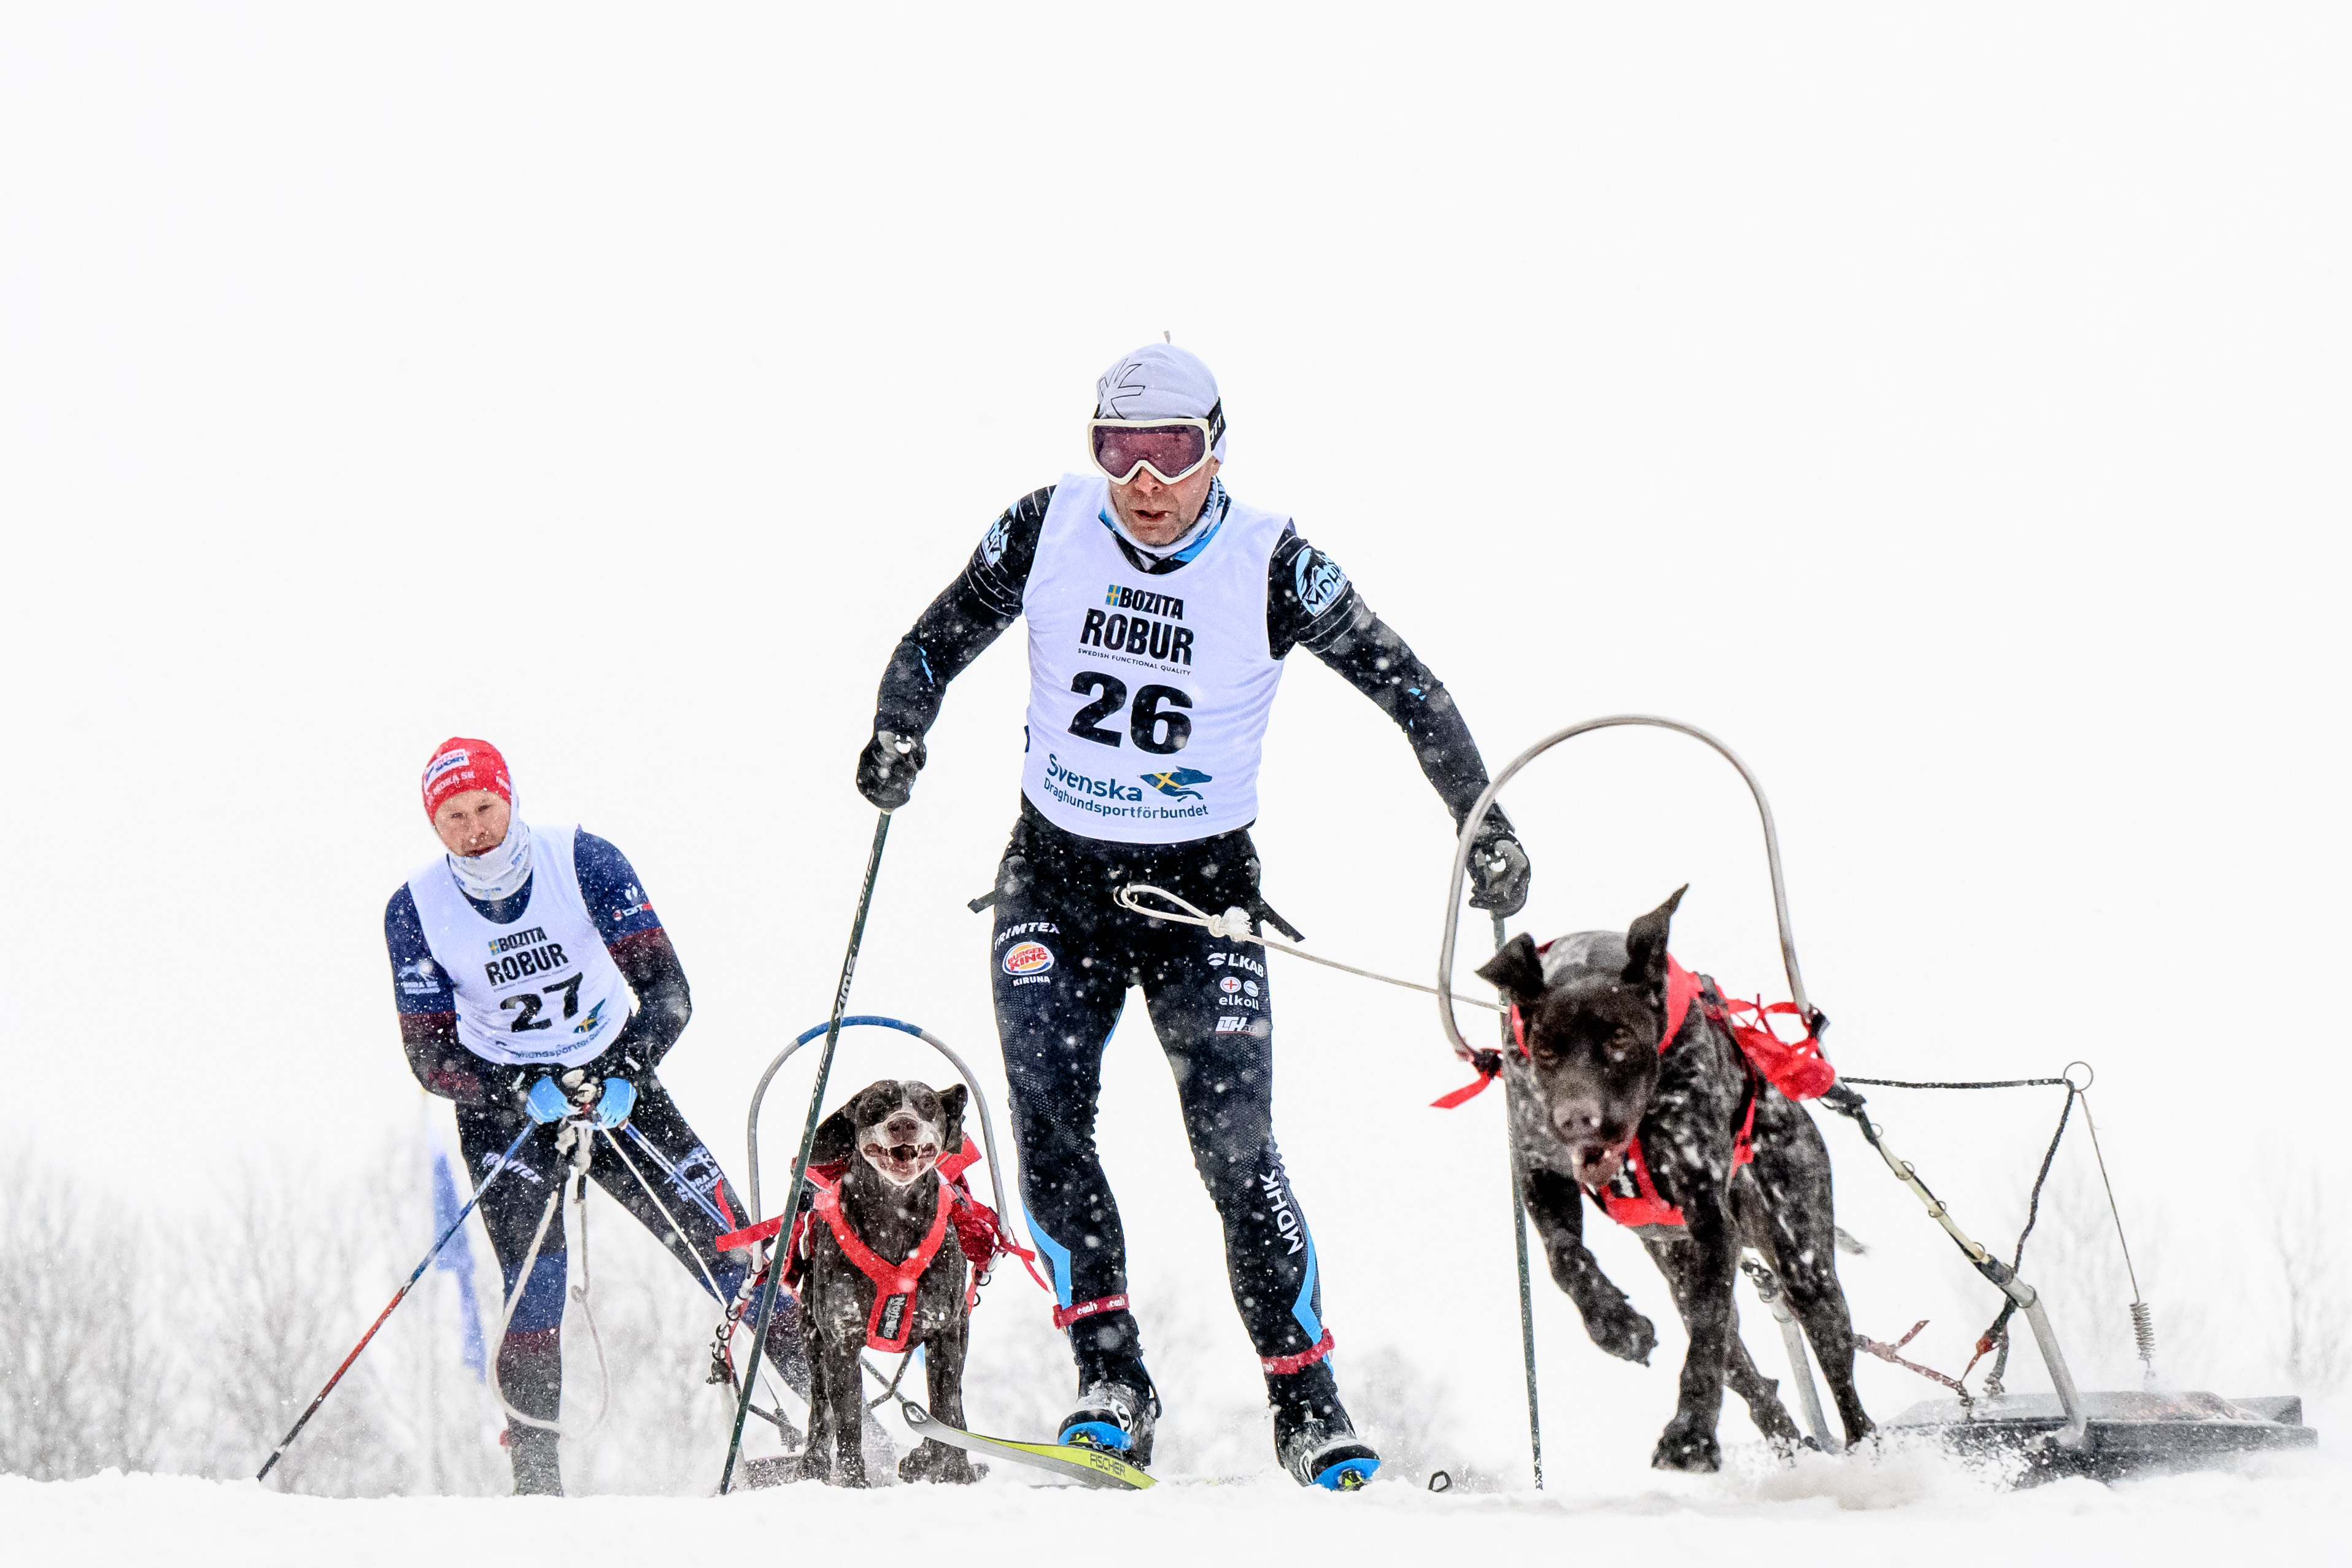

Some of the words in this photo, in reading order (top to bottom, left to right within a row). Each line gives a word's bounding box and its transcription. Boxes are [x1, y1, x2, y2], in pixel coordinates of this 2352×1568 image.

[1118, 587, 1184, 620] BOZITA
[1080, 608, 1194, 666] ROBUR
[1078, 647, 1109, 659] SWEDISH
[1112, 655, 1158, 669] FUNCTIONAL
[1161, 665, 1191, 676] QUALITY
[1068, 671, 1193, 755] 26
[1046, 753, 1142, 801] Svenska
[1044, 777, 1209, 819] Draghundsportförbundet
[498, 926, 547, 952] BOZITA
[994, 922, 1060, 951] TRIMTEX
[484, 943, 568, 986] ROBUR
[1008, 947, 1045, 965] BURGER
[1010, 953, 1047, 971] KING
[1228, 953, 1264, 978] LKAB
[1013, 976, 1050, 987] KIRUNA
[500, 971, 583, 1033] 27
[1219, 994, 1259, 1010] elkoll
[1259, 1168, 1304, 1255] MDHK
[1090, 1453, 1126, 1478] FISCHER
